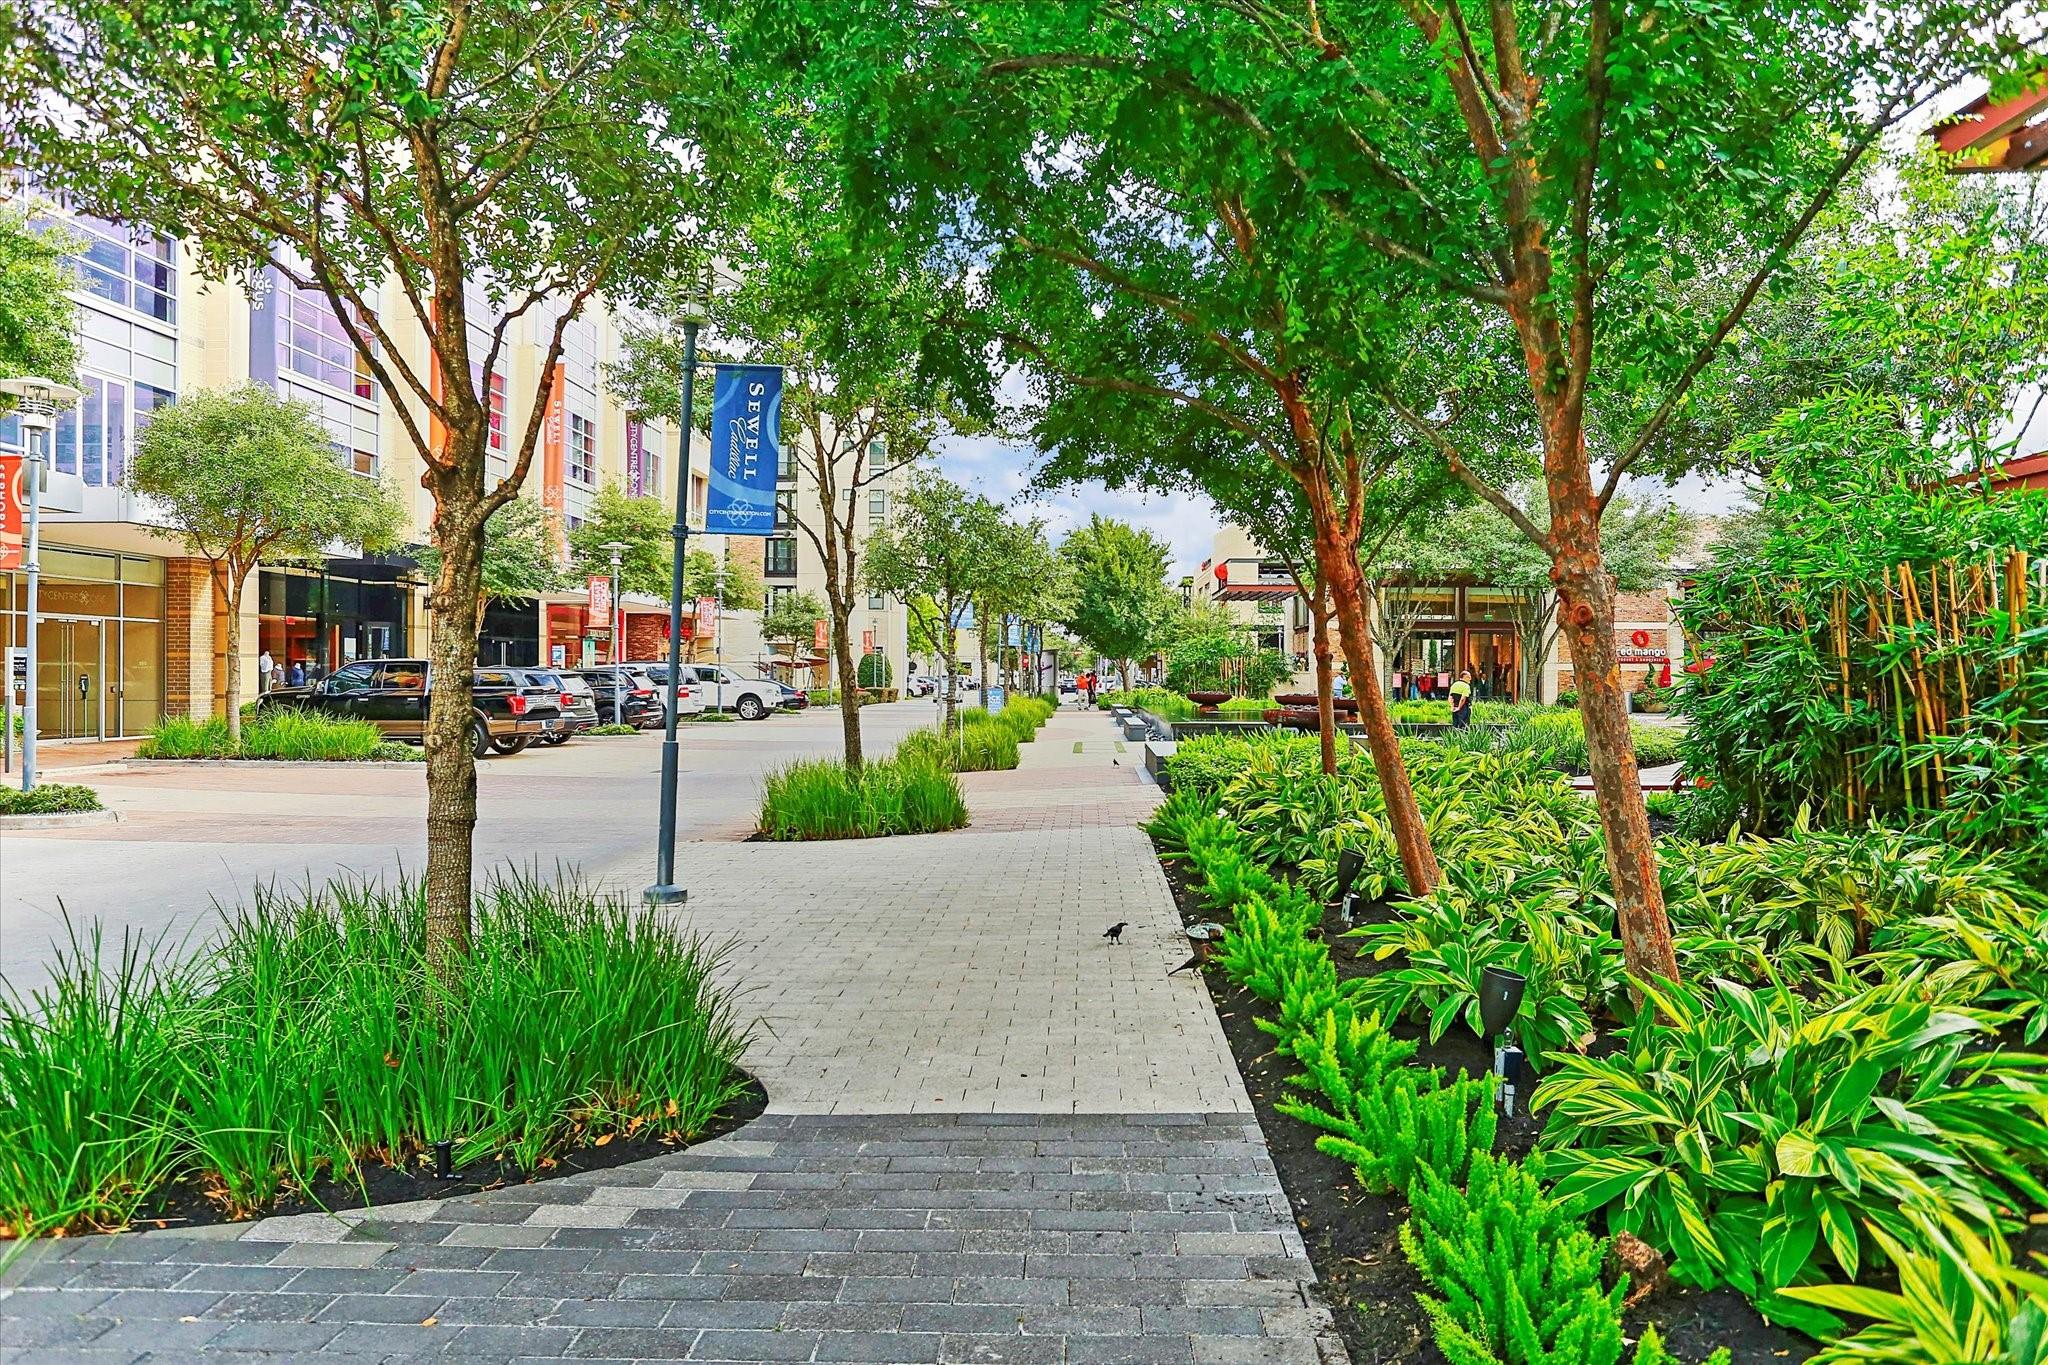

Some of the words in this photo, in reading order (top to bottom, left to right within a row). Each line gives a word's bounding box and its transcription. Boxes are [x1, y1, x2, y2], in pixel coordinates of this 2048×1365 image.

[251, 268, 266, 311] egus
[553, 400, 562, 443] SEWELL
[743, 382, 765, 481] SEWELL
[728, 416, 747, 480] Cadillac
[1634, 649, 1666, 657] mango
